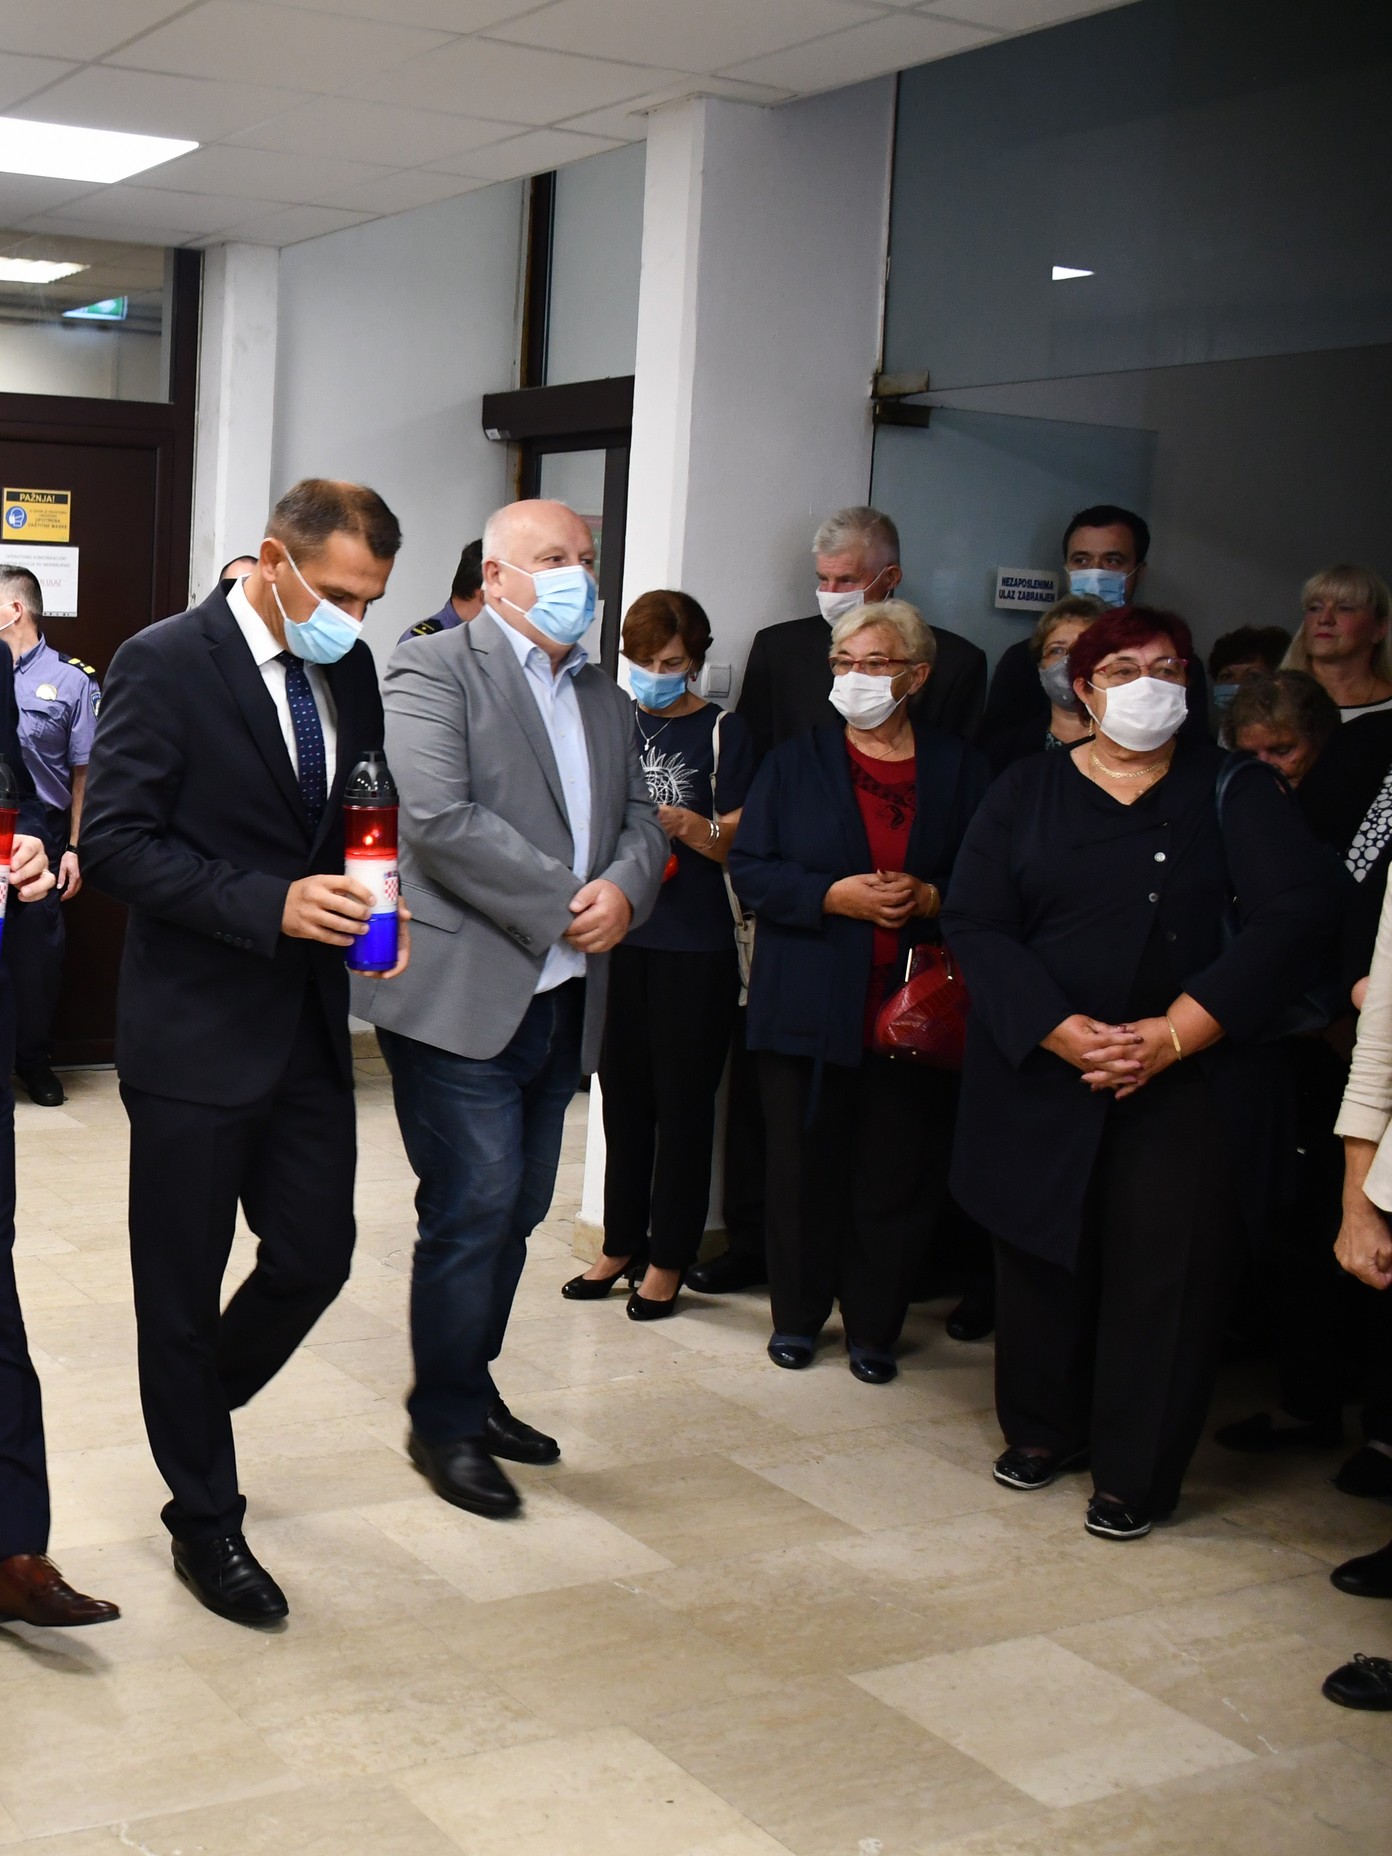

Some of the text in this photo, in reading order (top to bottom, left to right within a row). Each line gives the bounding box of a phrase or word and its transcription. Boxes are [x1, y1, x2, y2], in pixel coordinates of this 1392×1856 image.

[19, 493, 55, 503] PAŽNJA!
[1002, 577, 1053, 589] NEZAPOSLENIMA
[999, 589, 1055, 602] ULAZ ZABRANJEN
